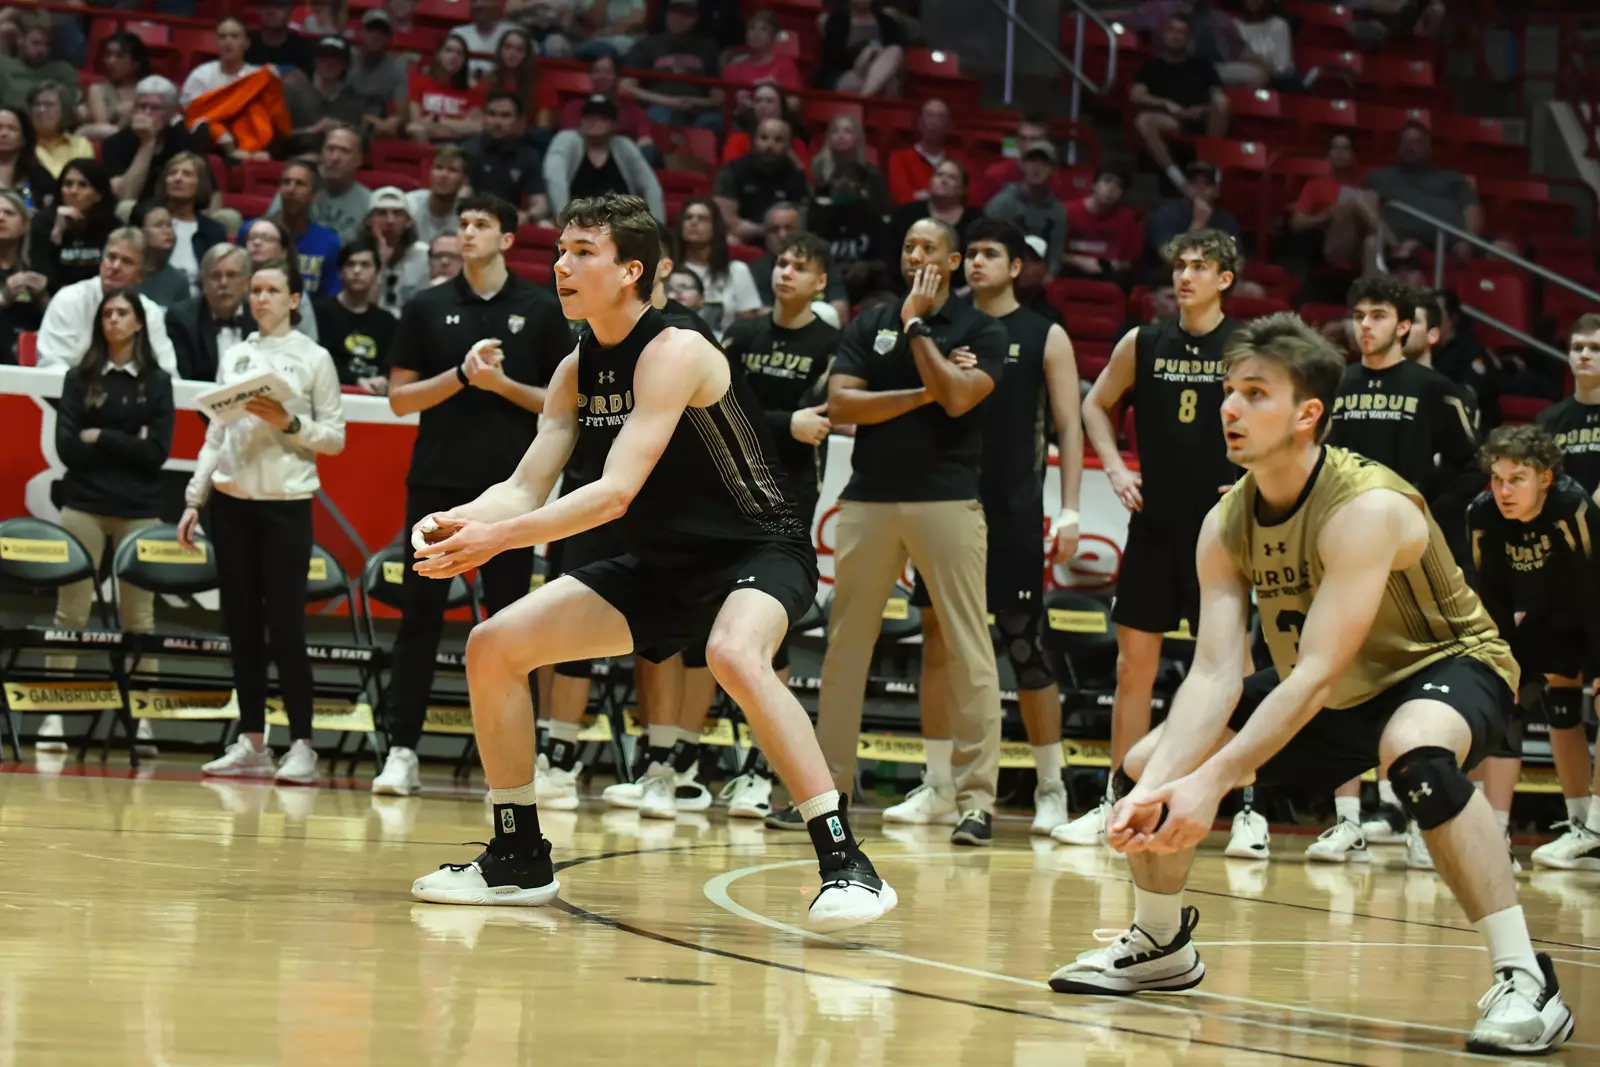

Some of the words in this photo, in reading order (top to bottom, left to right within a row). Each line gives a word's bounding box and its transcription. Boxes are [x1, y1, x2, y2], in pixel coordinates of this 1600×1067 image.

[741, 351, 813, 373] UDUE
[1154, 358, 1226, 374] PURDUE
[578, 390, 633, 415] PRD
[1178, 389, 1198, 423] 8
[1332, 394, 1419, 414] PURDUE
[585, 416, 604, 427] FRT
[605, 413, 630, 426] WAY
[1344, 410, 1367, 420] FORT
[1368, 410, 1401, 421] WAYNE
[1553, 427, 1600, 448] PURD
[44, 630, 78, 642] BALL
[81, 632, 122, 643] STATE
[163, 638, 198, 650] BALL
[202, 640, 229, 651] STA
[306, 647, 328, 658] ALL
[331, 648, 372, 660] STATE
[435, 652, 458, 664] ALL
[29, 687, 118, 704] GAINBRIDGE
[874, 740, 923, 753] GAINBR
